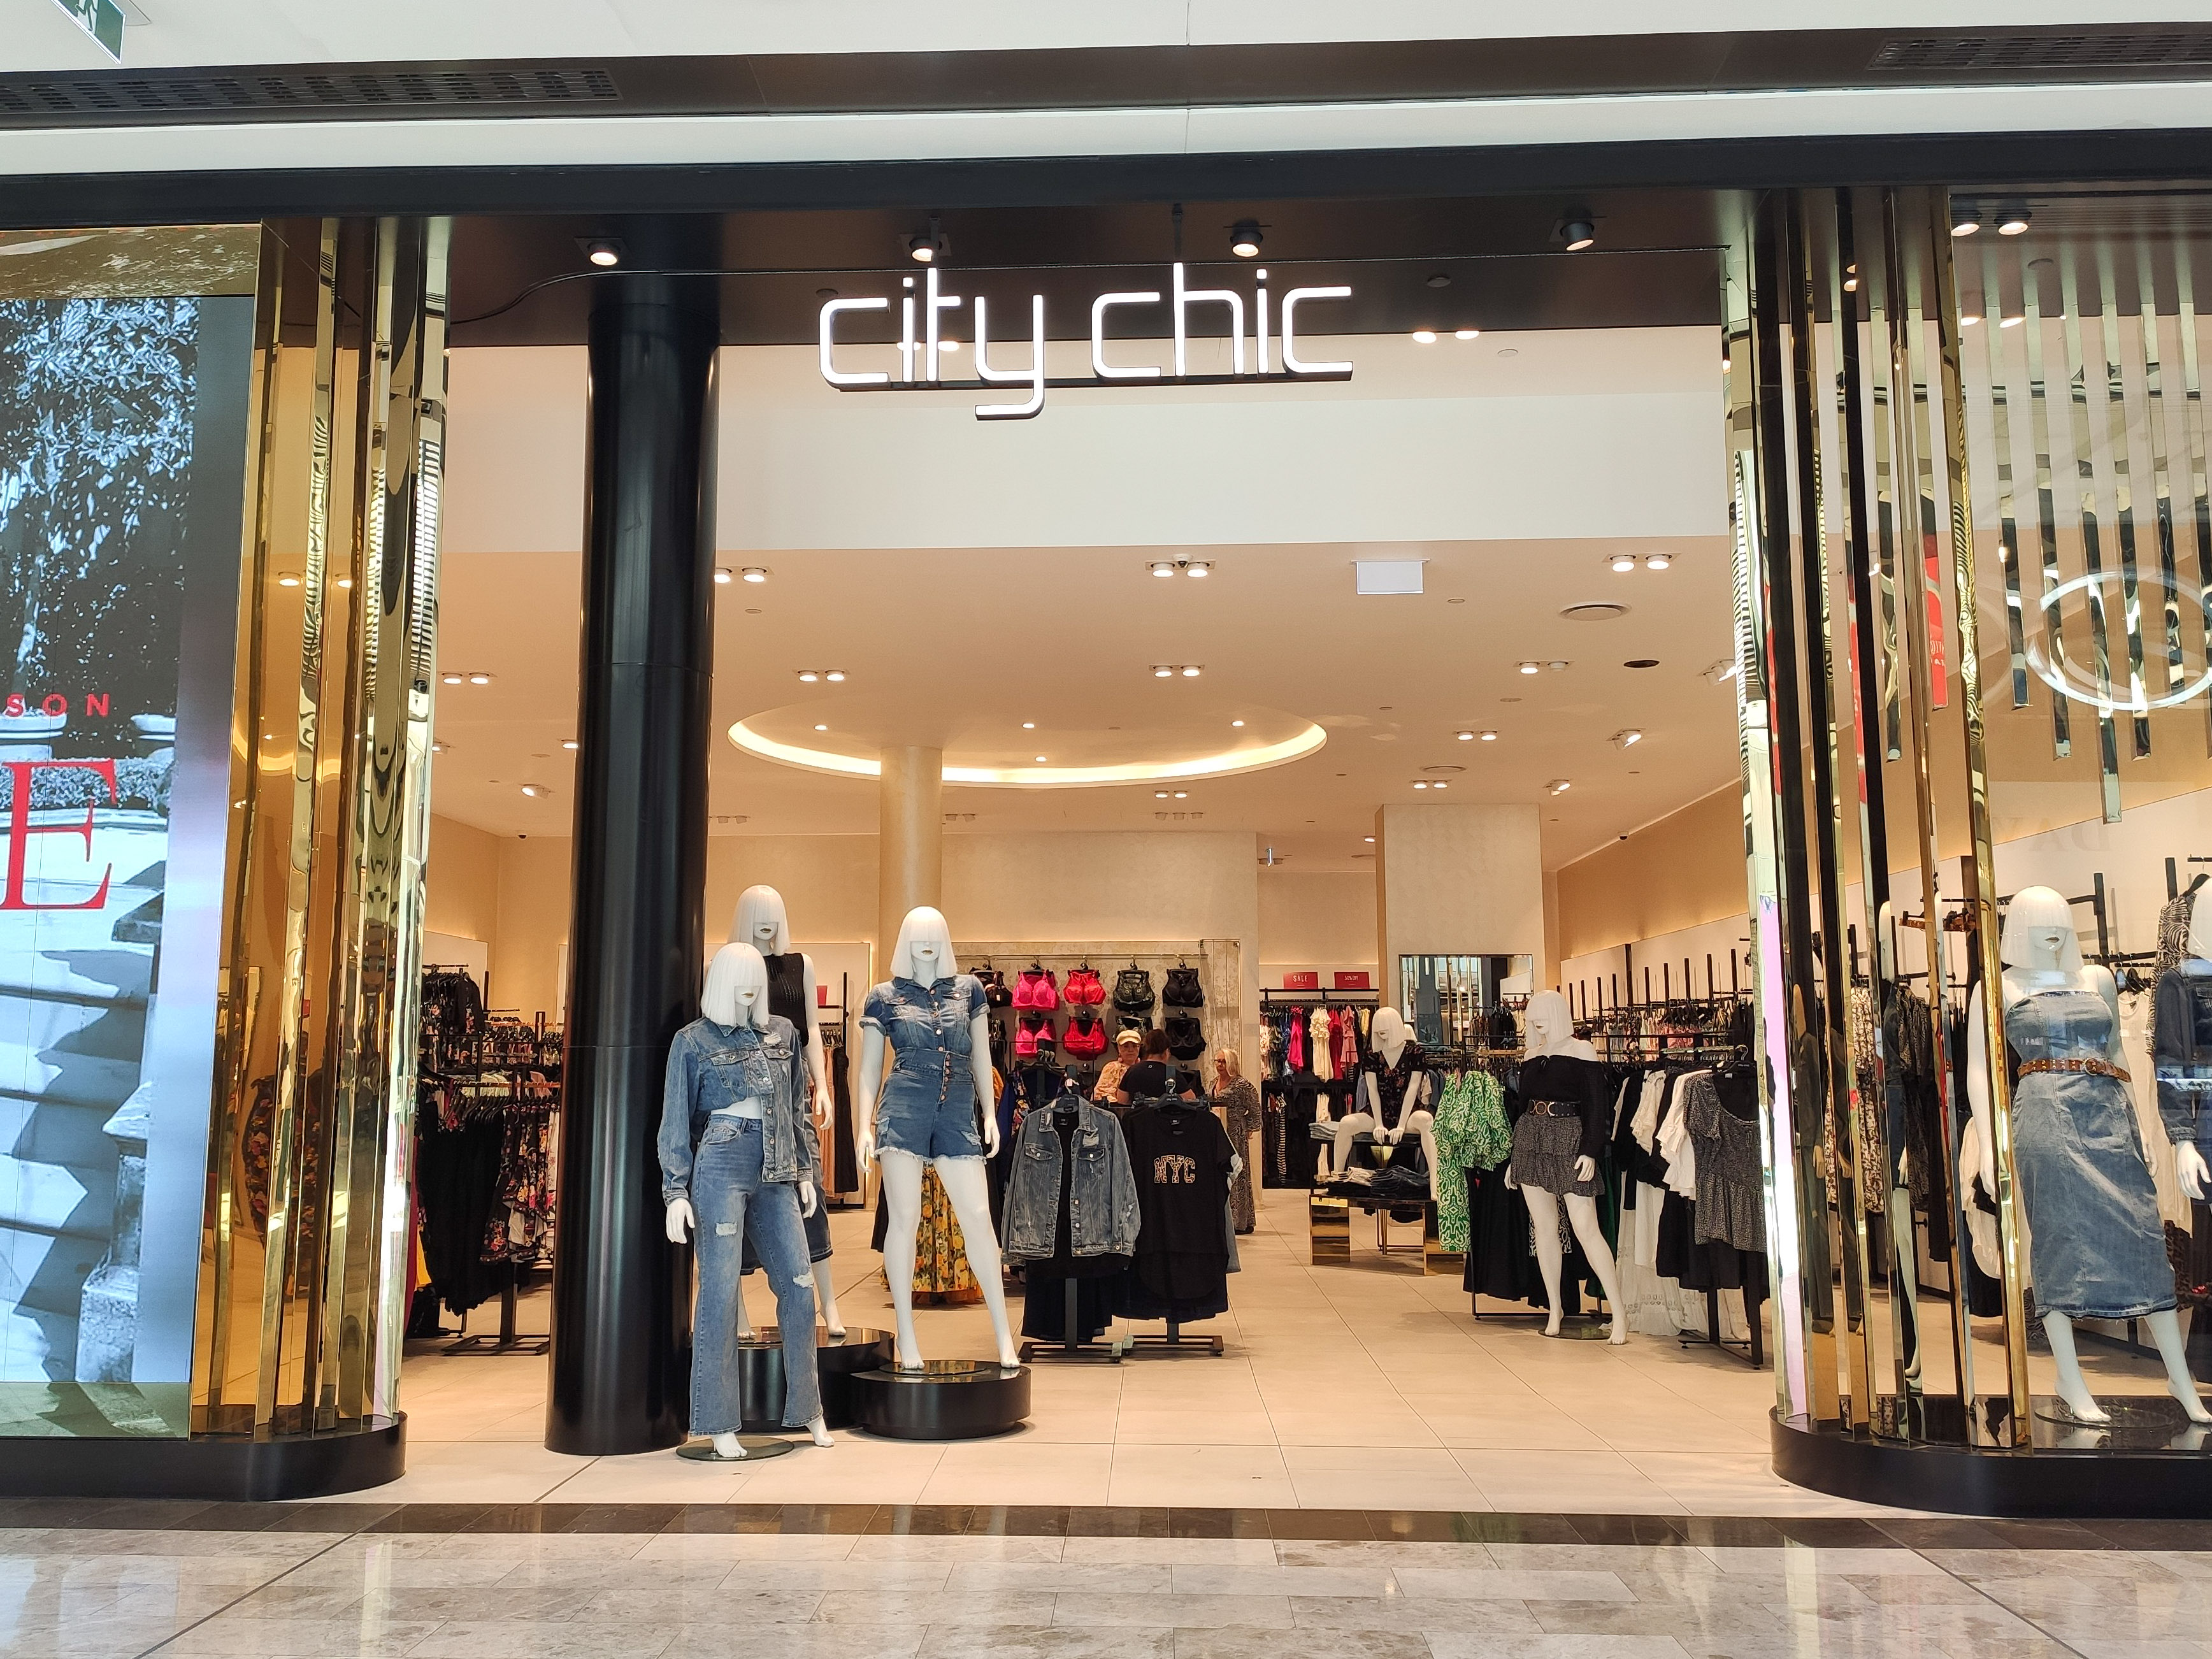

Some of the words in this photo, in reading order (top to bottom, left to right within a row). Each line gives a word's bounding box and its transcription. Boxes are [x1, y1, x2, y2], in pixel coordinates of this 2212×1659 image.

[819, 267, 1045, 421] city
[1091, 262, 1353, 382] chic
[4, 693, 110, 717] SON
[0, 758, 117, 910] E
[1154, 1154, 1196, 1184] NYC
